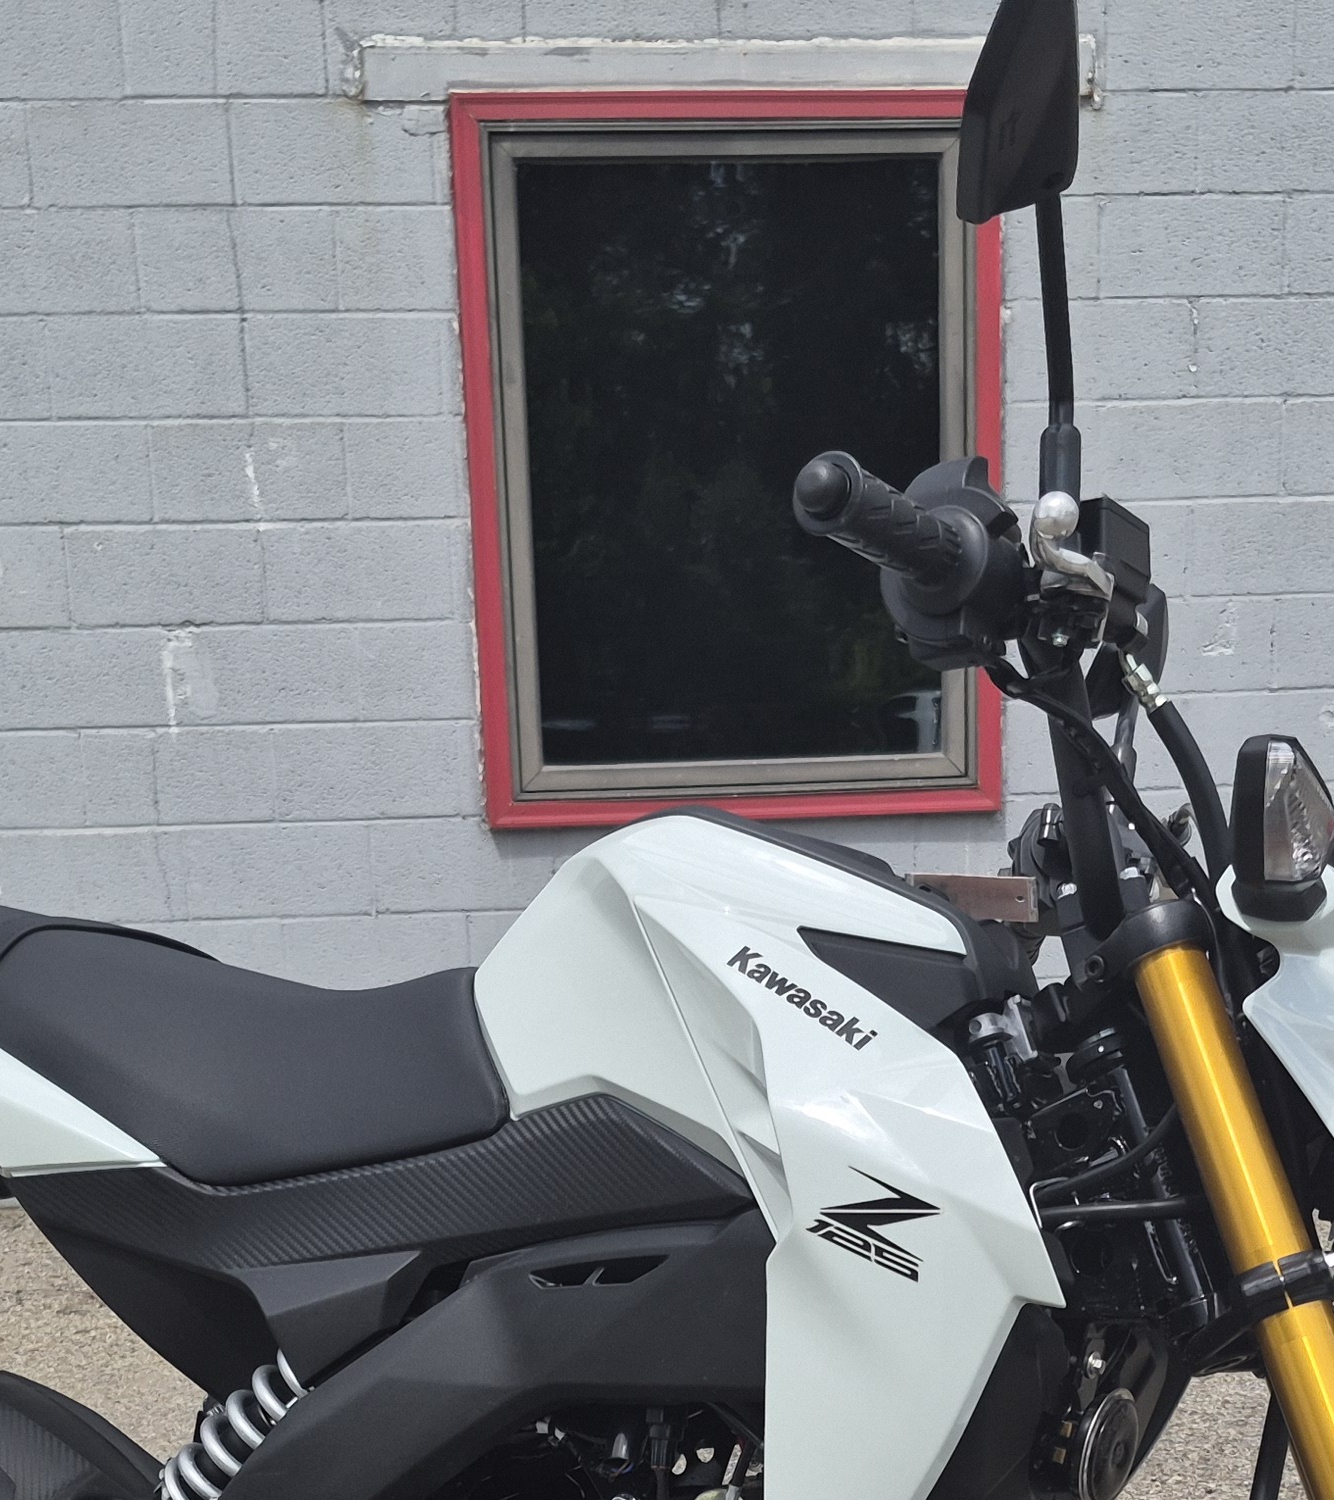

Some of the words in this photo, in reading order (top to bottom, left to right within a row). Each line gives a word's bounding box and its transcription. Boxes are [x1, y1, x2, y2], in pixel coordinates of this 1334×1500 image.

[726, 946, 877, 1051] Kawasaki
[805, 1219, 920, 1282] 125
[819, 1166, 941, 1262] Z
